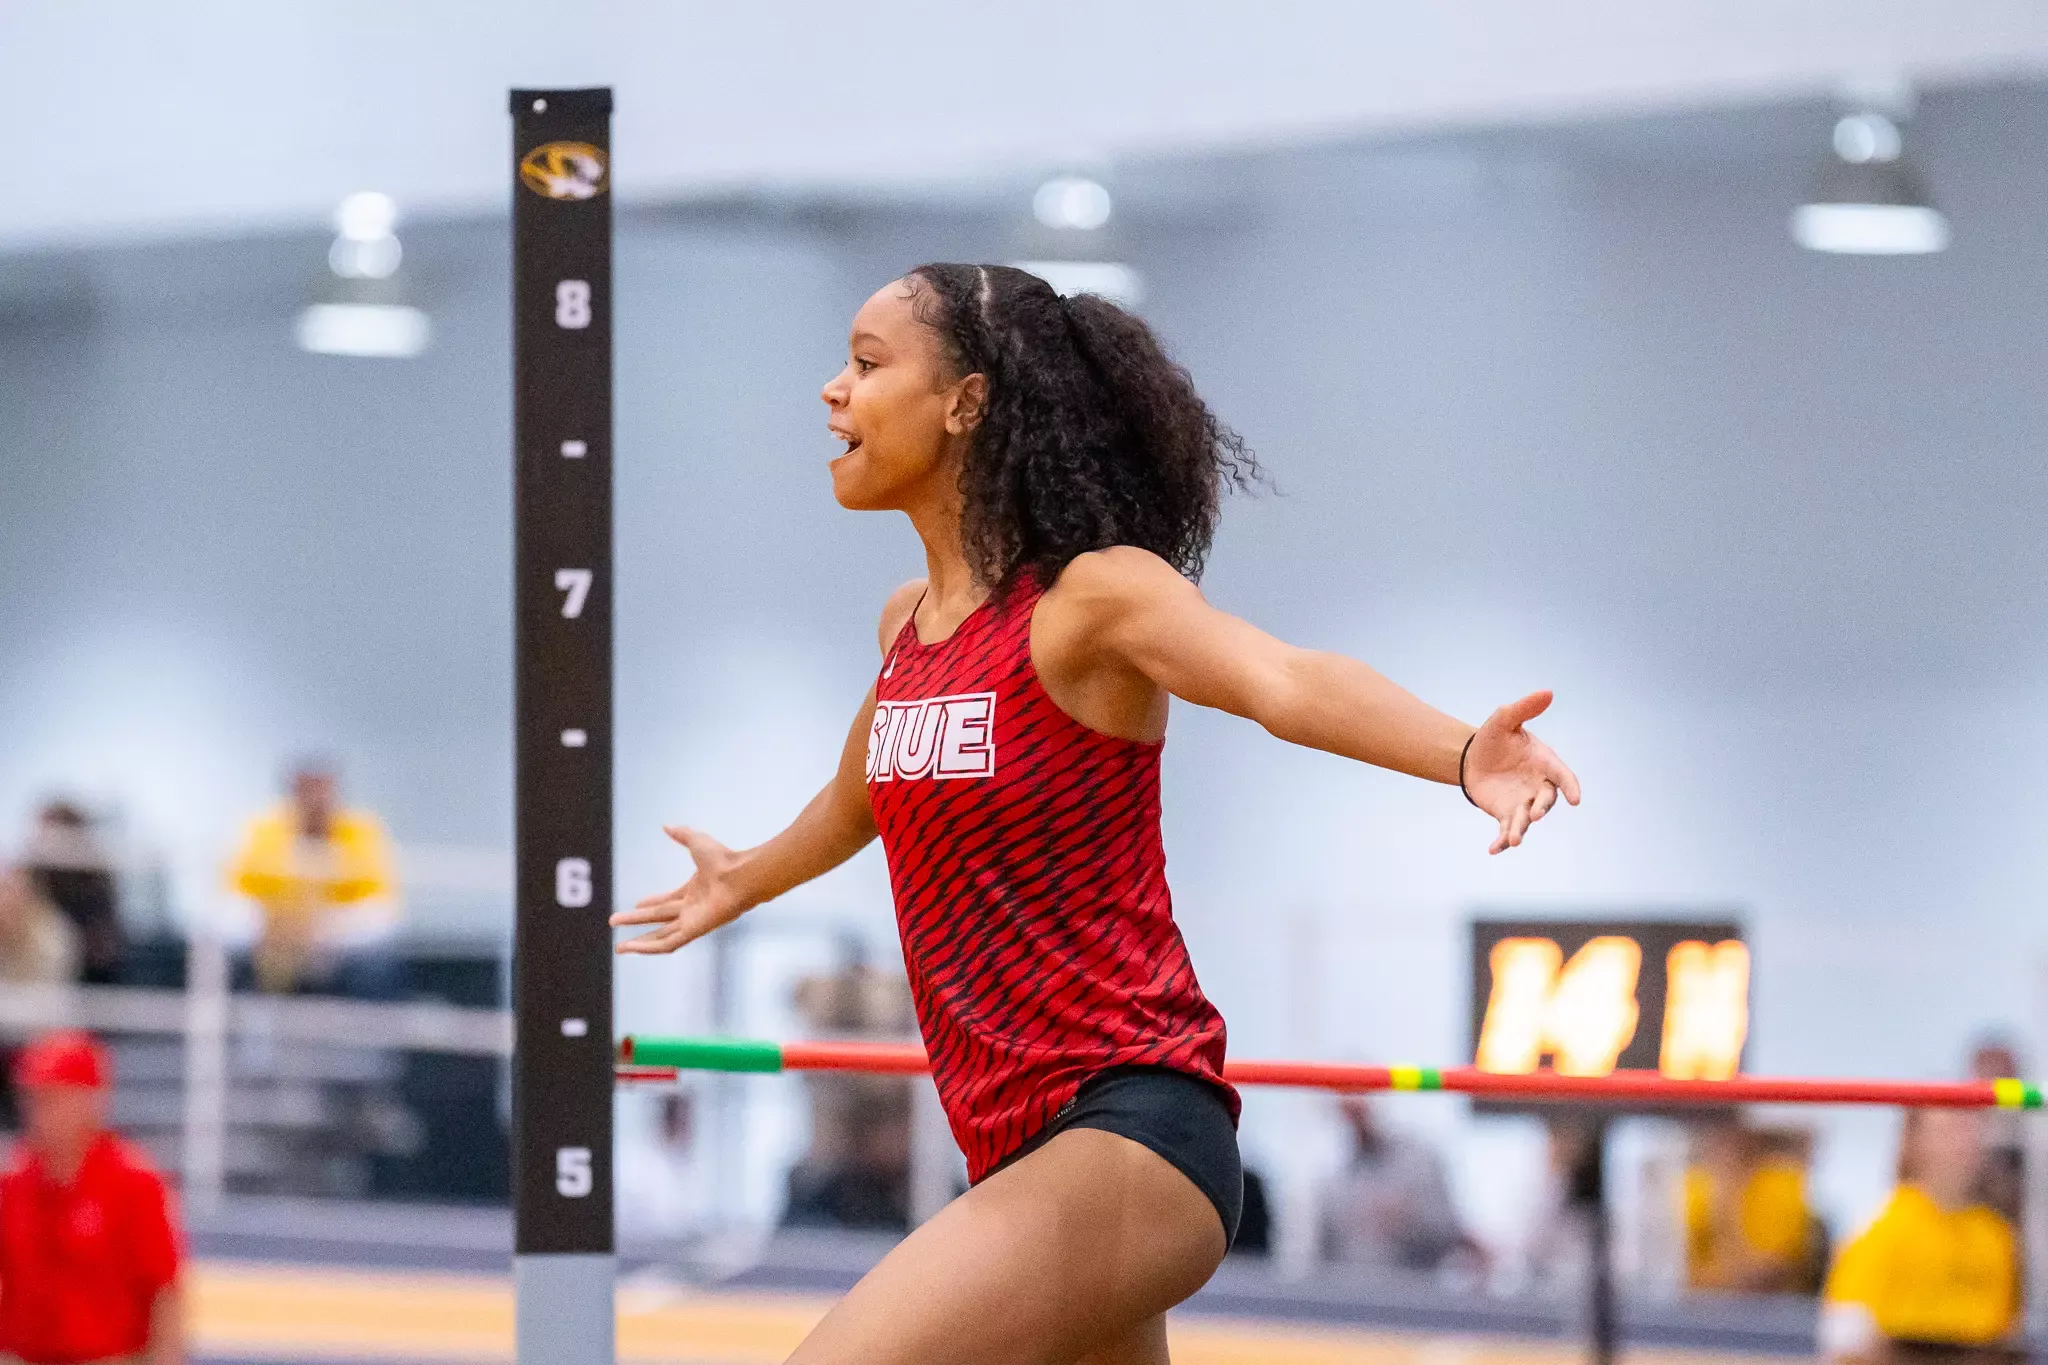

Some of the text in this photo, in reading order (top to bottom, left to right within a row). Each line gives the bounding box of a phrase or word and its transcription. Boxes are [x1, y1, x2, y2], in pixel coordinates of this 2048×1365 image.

[555, 279, 591, 329] 8
[554, 569, 593, 619] 7
[556, 857, 592, 908] 6
[556, 1147, 592, 1198] 5
